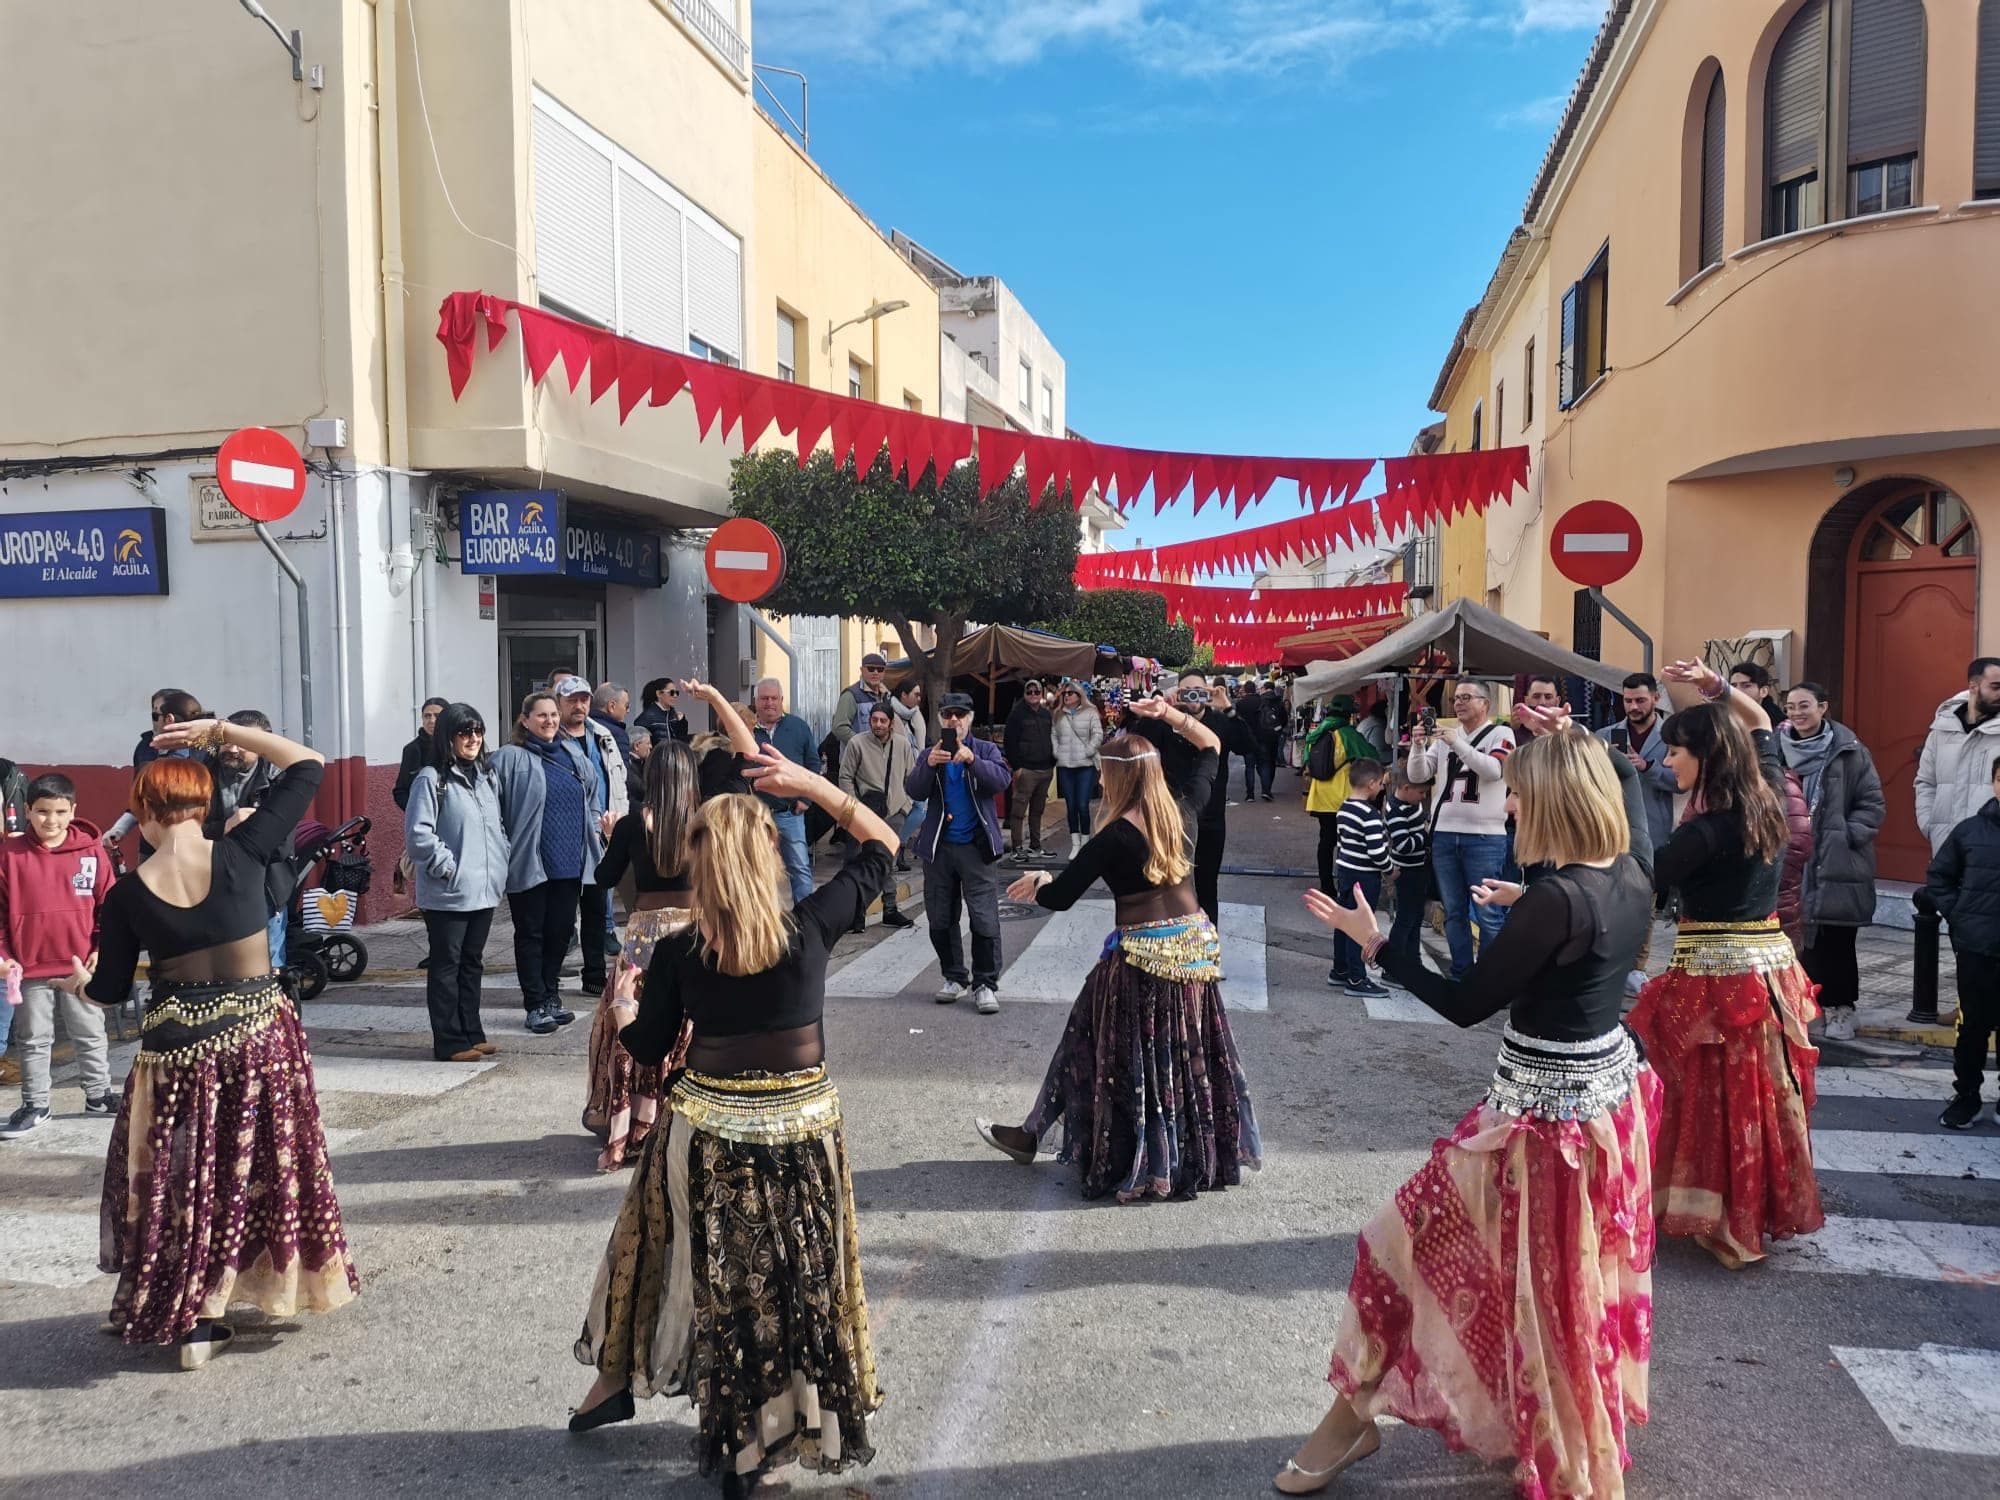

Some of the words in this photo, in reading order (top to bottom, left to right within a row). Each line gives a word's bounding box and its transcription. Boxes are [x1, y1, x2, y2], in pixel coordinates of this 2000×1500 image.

[470, 502, 510, 536] BAR
[42, 567, 55, 581] El
[57, 566, 98, 581] Alcalde
[79, 856, 98, 889] A
